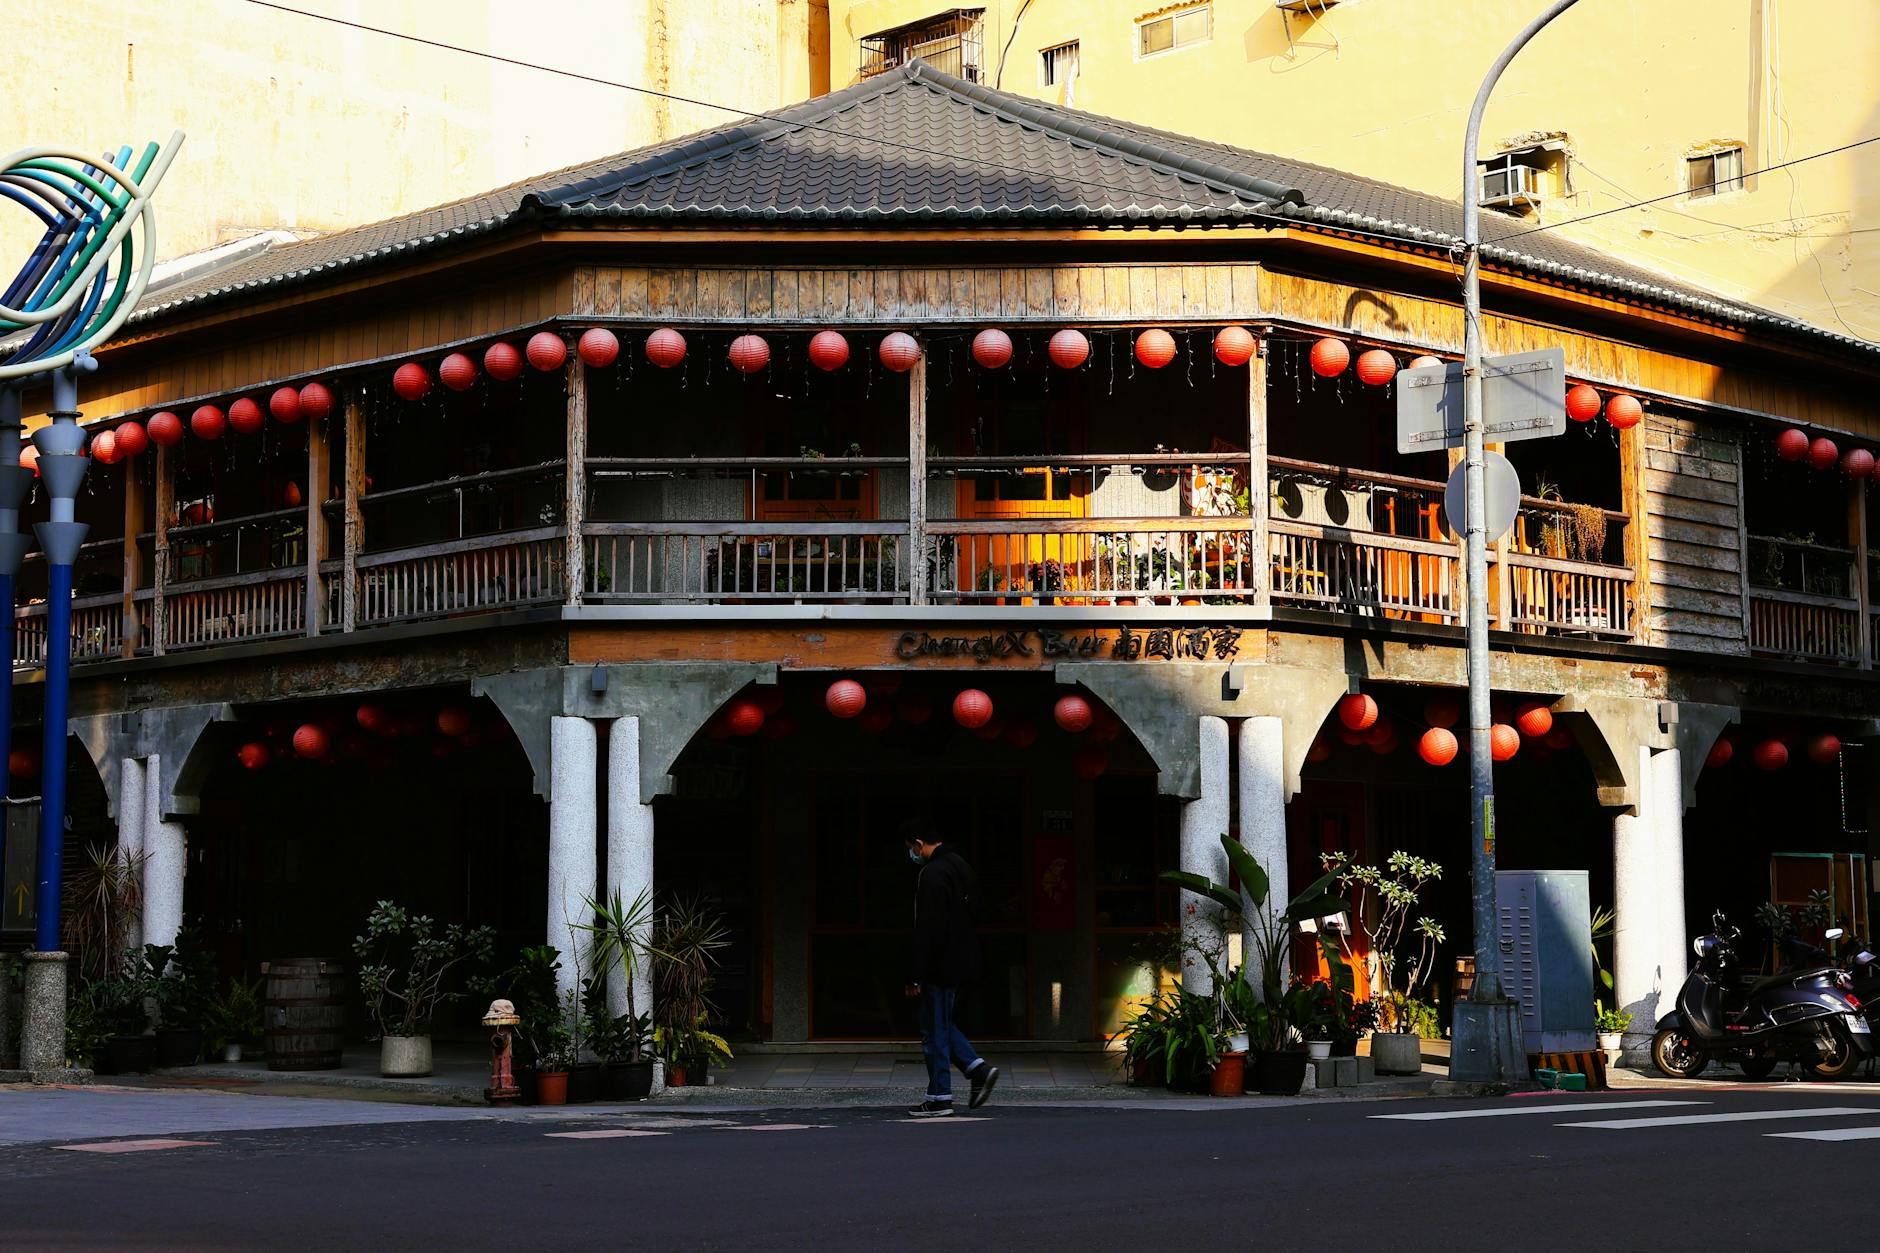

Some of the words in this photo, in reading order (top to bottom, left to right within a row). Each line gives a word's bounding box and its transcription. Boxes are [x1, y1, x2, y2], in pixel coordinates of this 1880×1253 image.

[1038, 628, 1109, 657] Beer
[1112, 624, 1244, 660] 南國酒家
